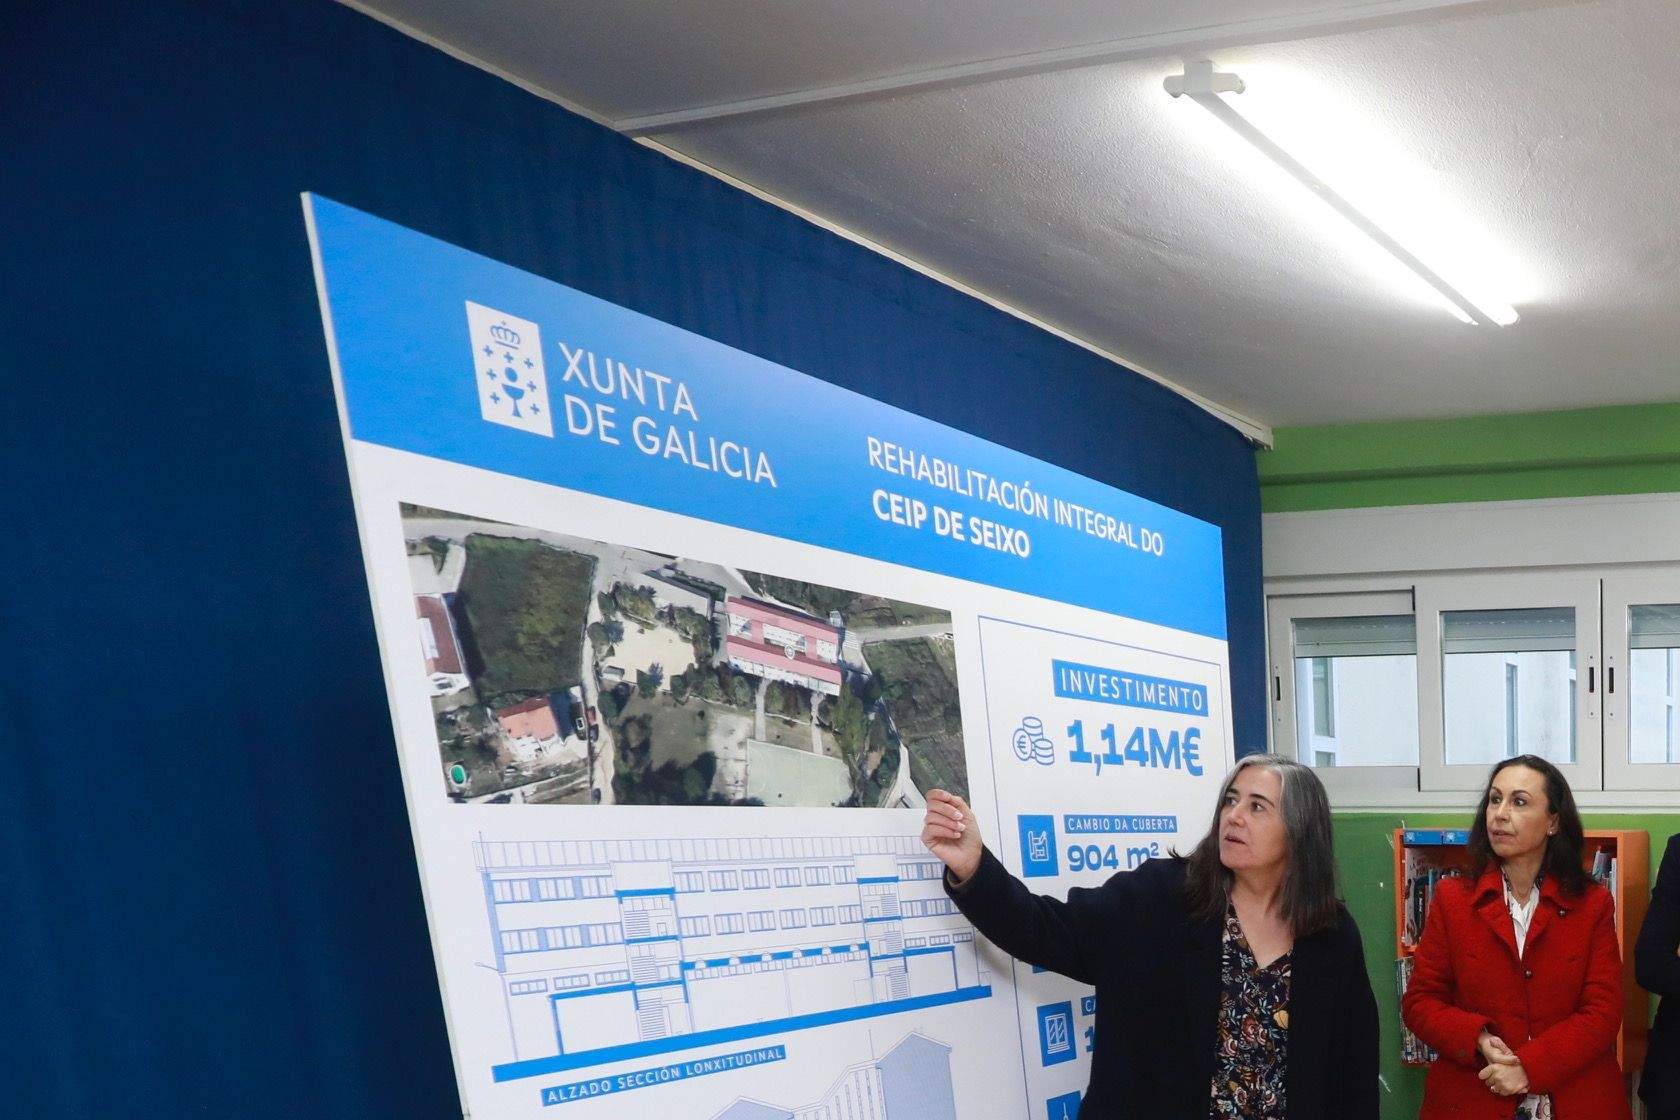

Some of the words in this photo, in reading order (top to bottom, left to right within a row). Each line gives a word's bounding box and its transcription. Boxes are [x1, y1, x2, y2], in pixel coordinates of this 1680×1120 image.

[558, 341, 698, 421] XUNTA
[564, 394, 620, 445] DE
[632, 415, 777, 488] GALICIA
[867, 436, 1049, 520] REHABILITACIÓN
[1054, 498, 1137, 549] INTEGRAL
[1141, 528, 1164, 557] DO
[872, 489, 927, 529] CEIP
[933, 505, 965, 541] DE
[969, 516, 1031, 558] SEIXO
[1061, 668, 1202, 710] INVESTIMENTO
[1067, 719, 1204, 776] 1,14M€
[1068, 818, 1110, 831] CAMBIO
[1115, 818, 1128, 831] DA
[1132, 818, 1176, 831] CUBERTA
[1066, 844, 1119, 872] 904
[548, 1080, 611, 1103] ALZADO
[617, 1066, 681, 1090] SECCIÓN
[685, 1048, 783, 1077] LONXITUDINAL
